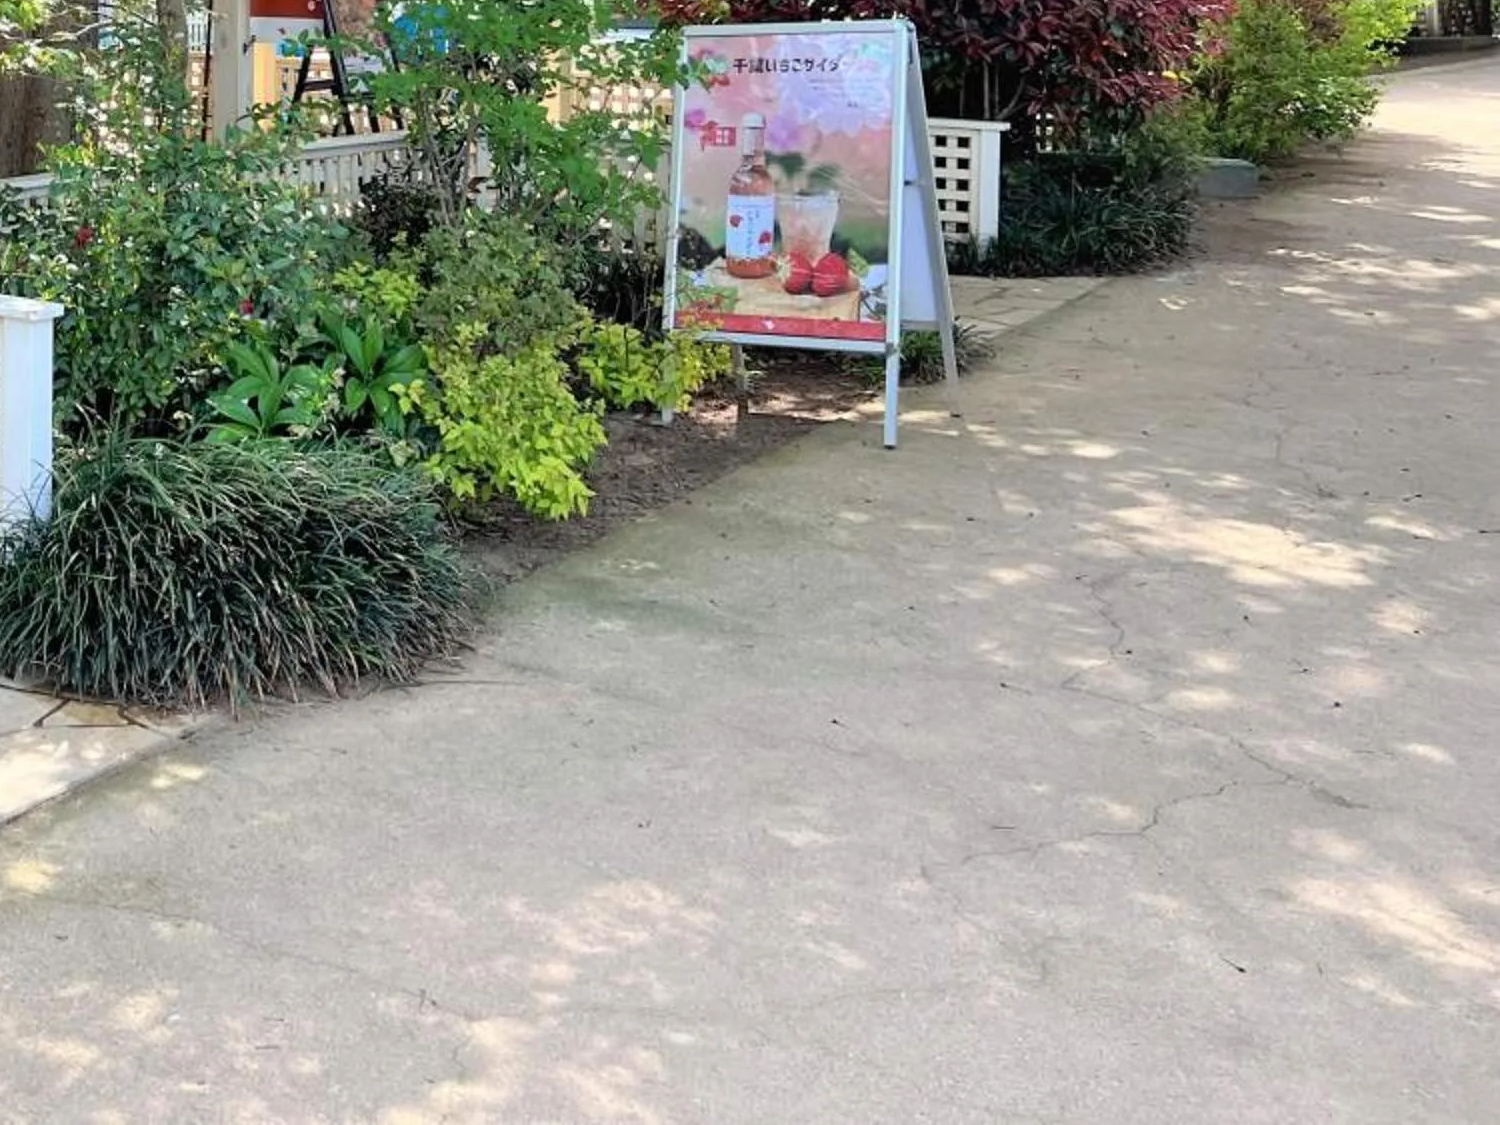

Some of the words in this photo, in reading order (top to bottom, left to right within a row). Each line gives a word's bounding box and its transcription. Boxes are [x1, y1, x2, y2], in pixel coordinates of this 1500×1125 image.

[732, 56, 853, 73] 千葉いちごサイダ
